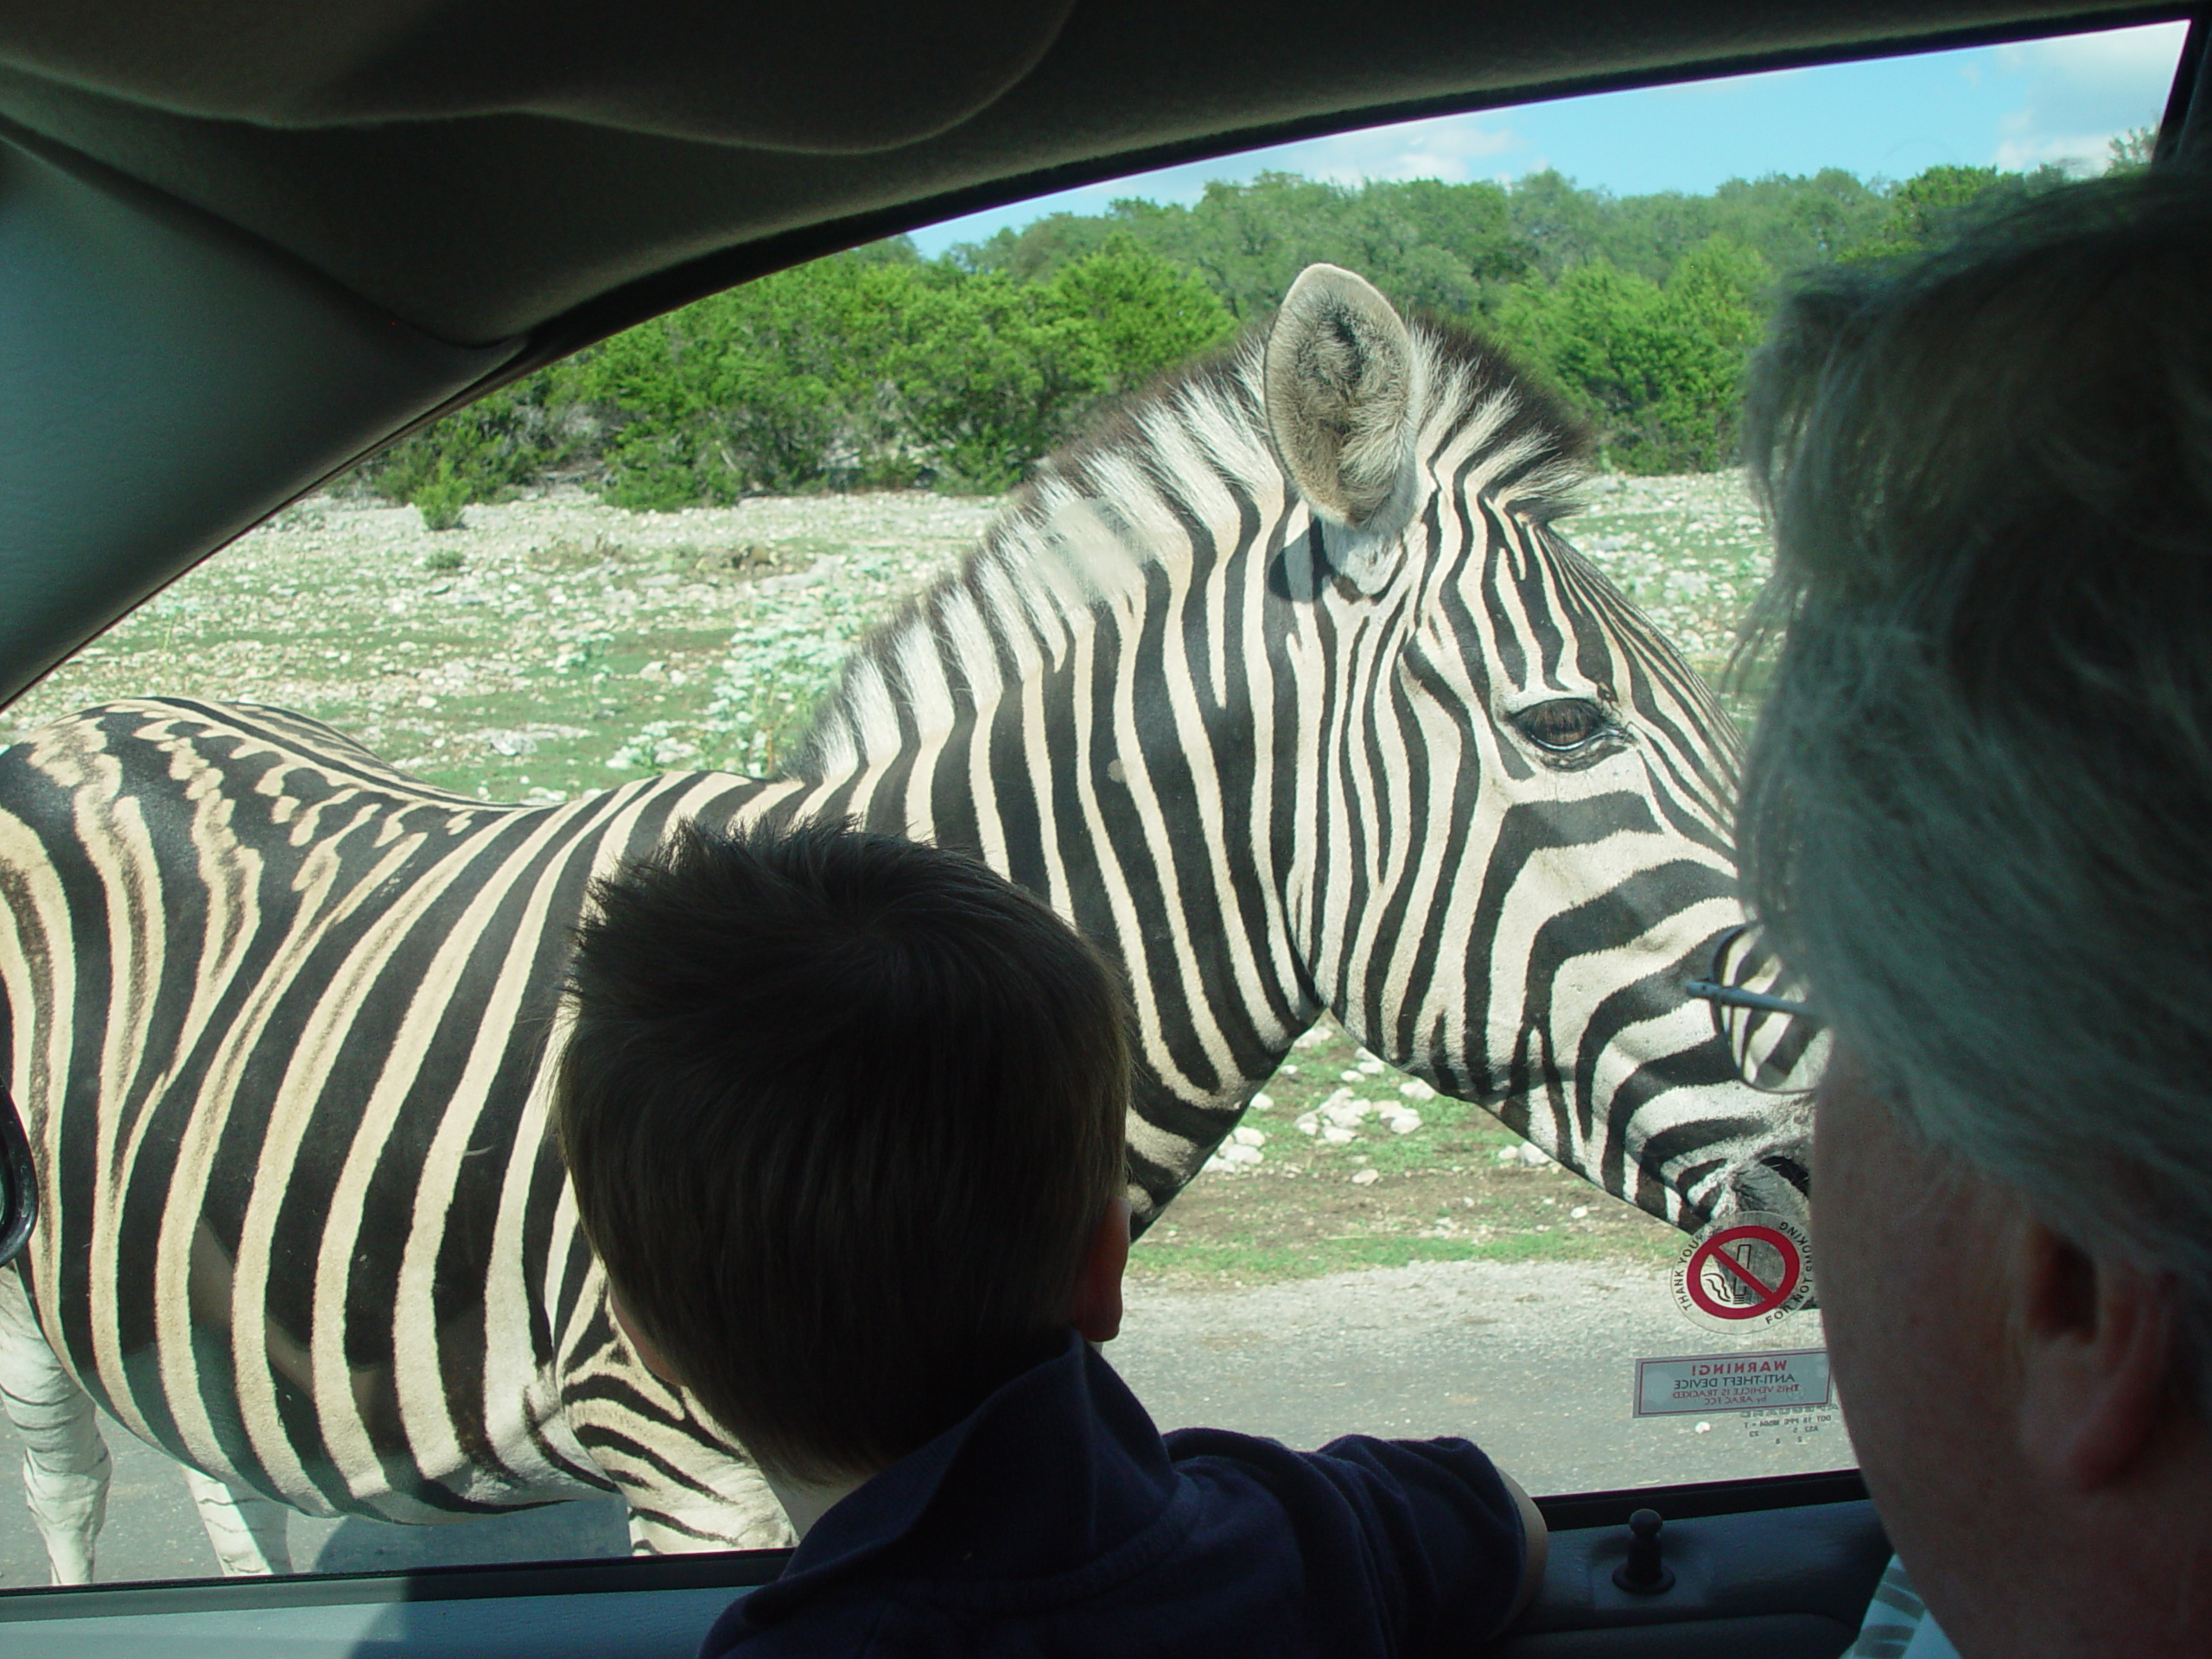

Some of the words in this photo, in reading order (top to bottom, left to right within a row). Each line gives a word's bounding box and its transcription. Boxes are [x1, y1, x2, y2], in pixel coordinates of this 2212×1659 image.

[1677, 1238, 1700, 1264] YOU
[1674, 1269, 1693, 1311] THANK
[1765, 1304, 1793, 1325] FOR
[1792, 1277, 1813, 1303] NOT
